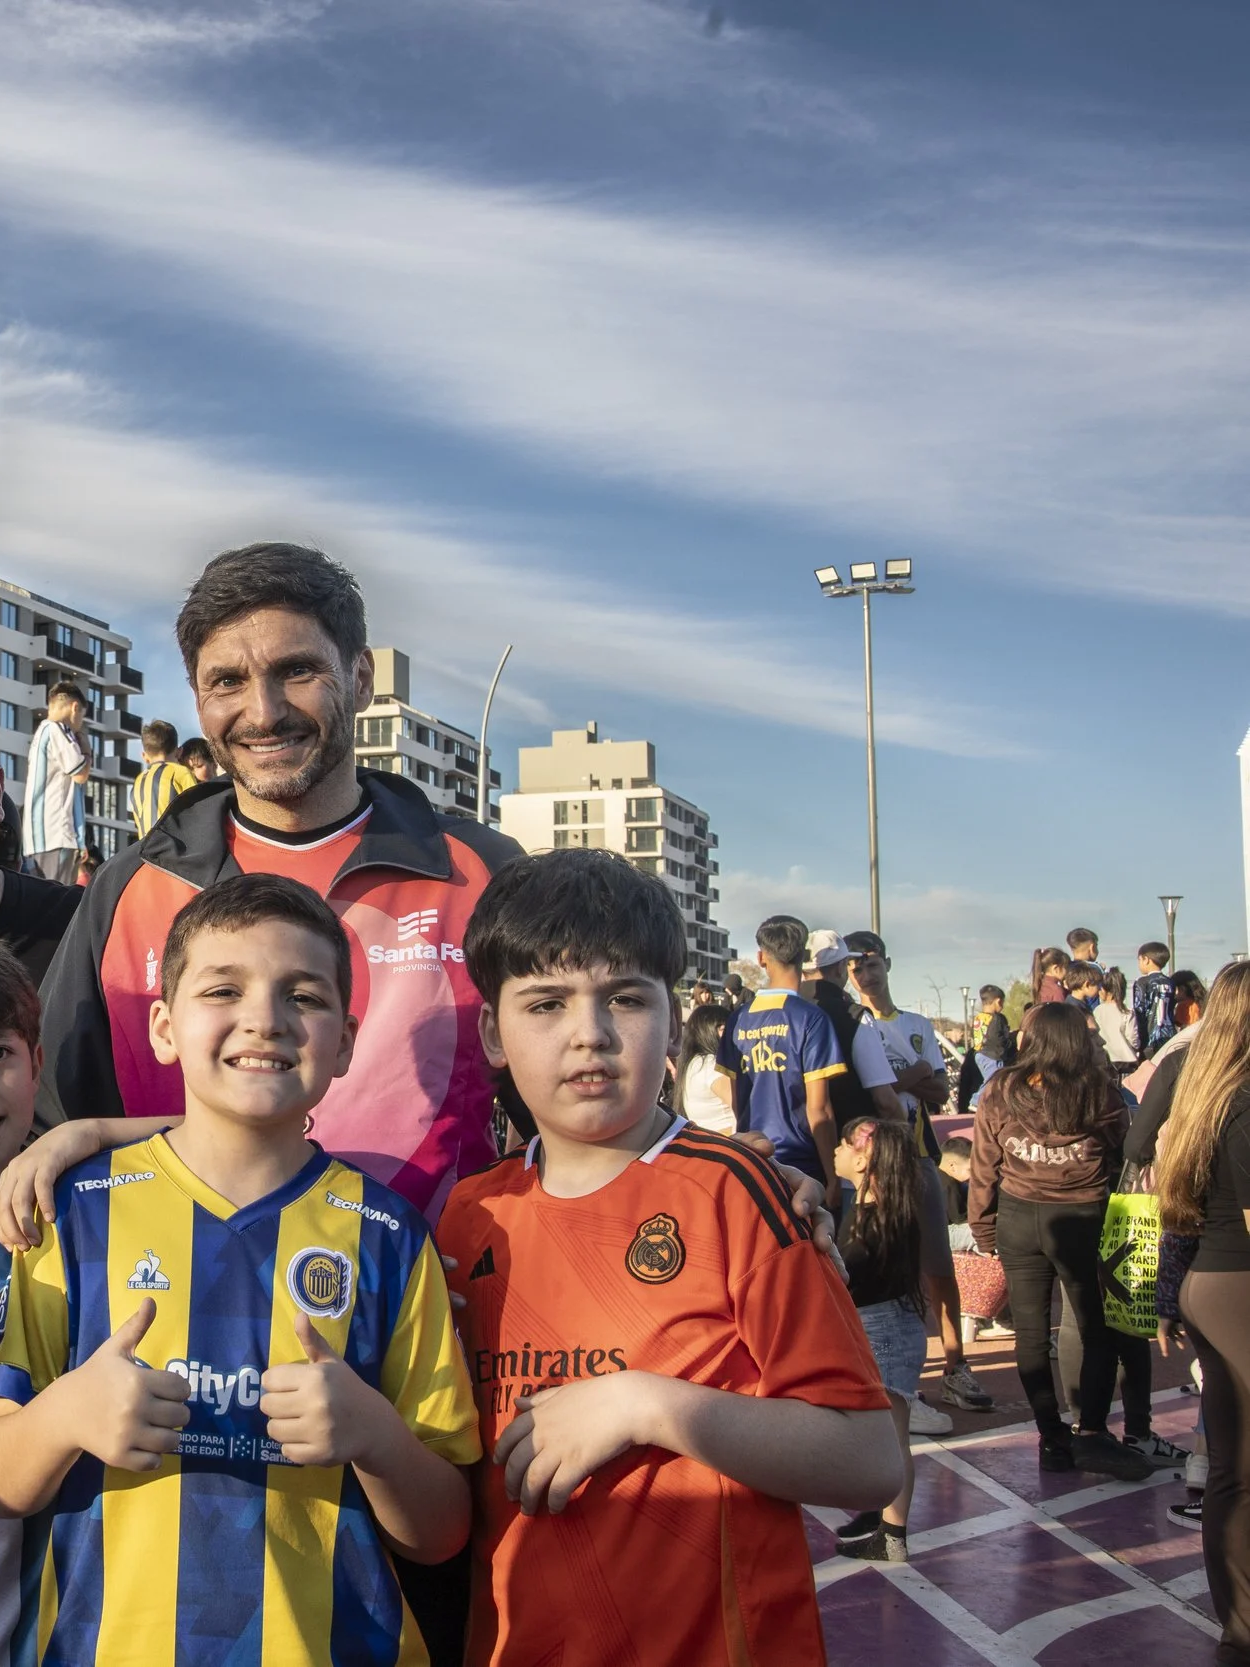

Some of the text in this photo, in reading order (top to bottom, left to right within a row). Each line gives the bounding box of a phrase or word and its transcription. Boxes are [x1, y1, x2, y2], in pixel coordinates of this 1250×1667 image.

[368, 942, 466, 964] Santa Fe
[393, 963, 442, 974] PROVINCIA
[475, 1342, 628, 1383] Emirates
[200, 1435, 225, 1446] PARA
[260, 1439, 282, 1450] Loter
[185, 1445, 198, 1454] DE
[199, 1446, 225, 1456] EDAD
[260, 1449, 293, 1464] San
